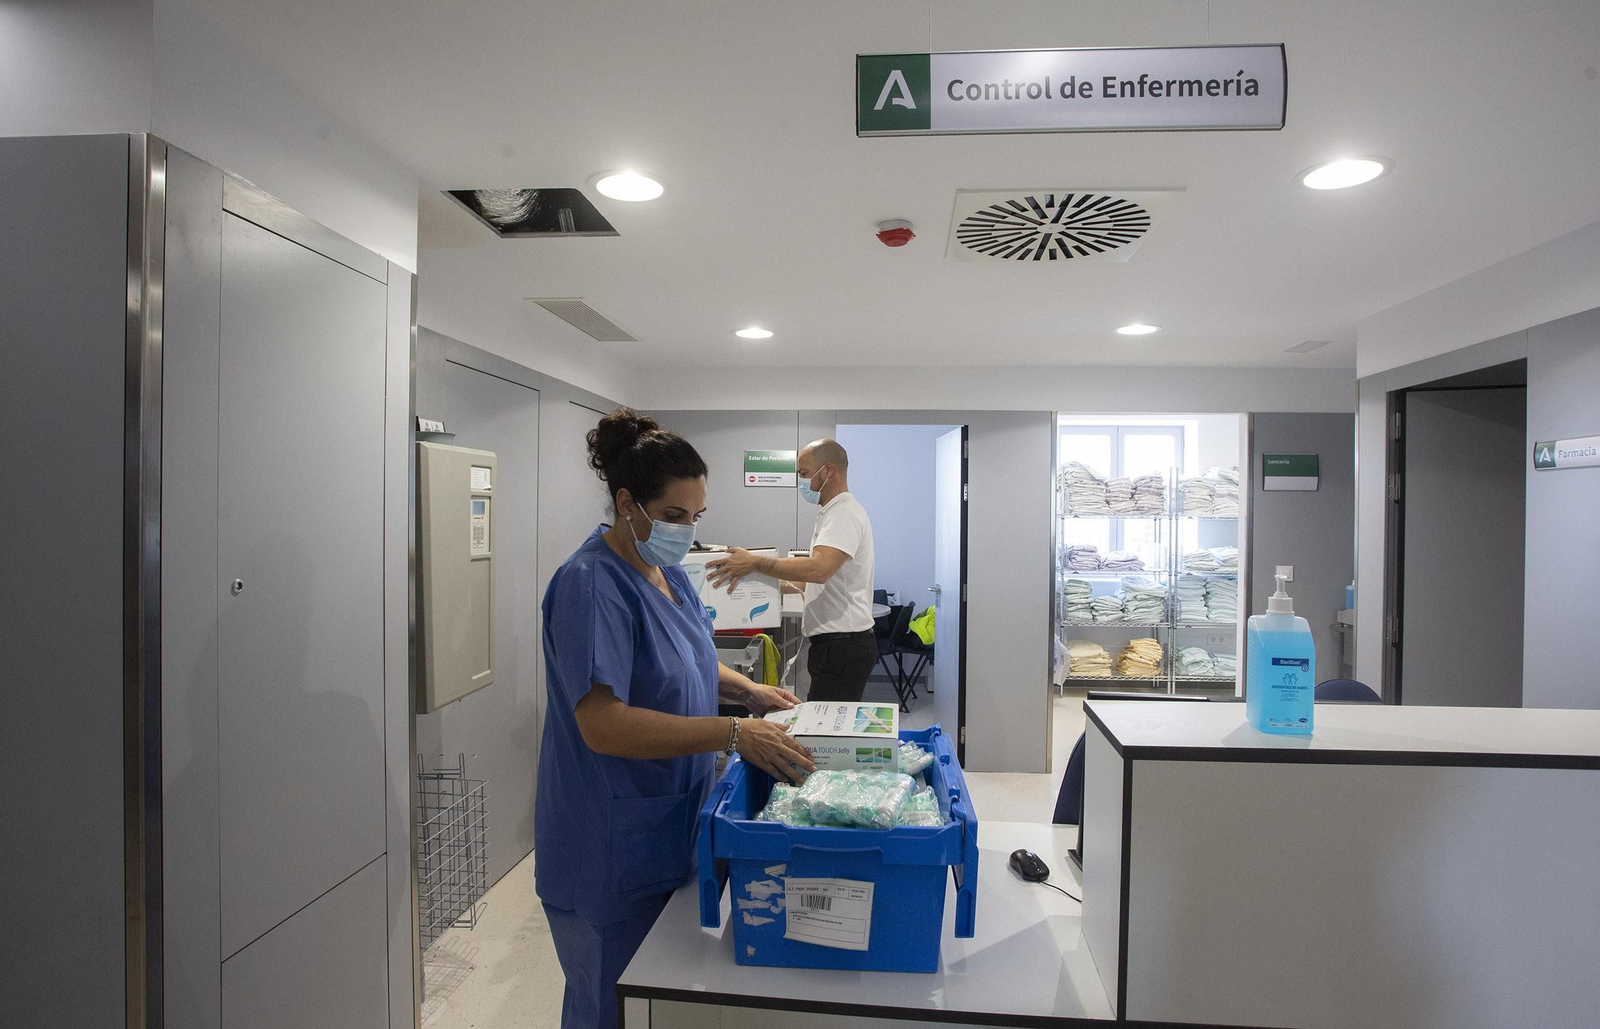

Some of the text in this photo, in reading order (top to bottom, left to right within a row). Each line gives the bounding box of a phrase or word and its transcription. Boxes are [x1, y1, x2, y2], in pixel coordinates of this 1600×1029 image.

[947, 69, 1260, 102] Control de Enfermería
[1558, 447, 1597, 459] Farmacia
